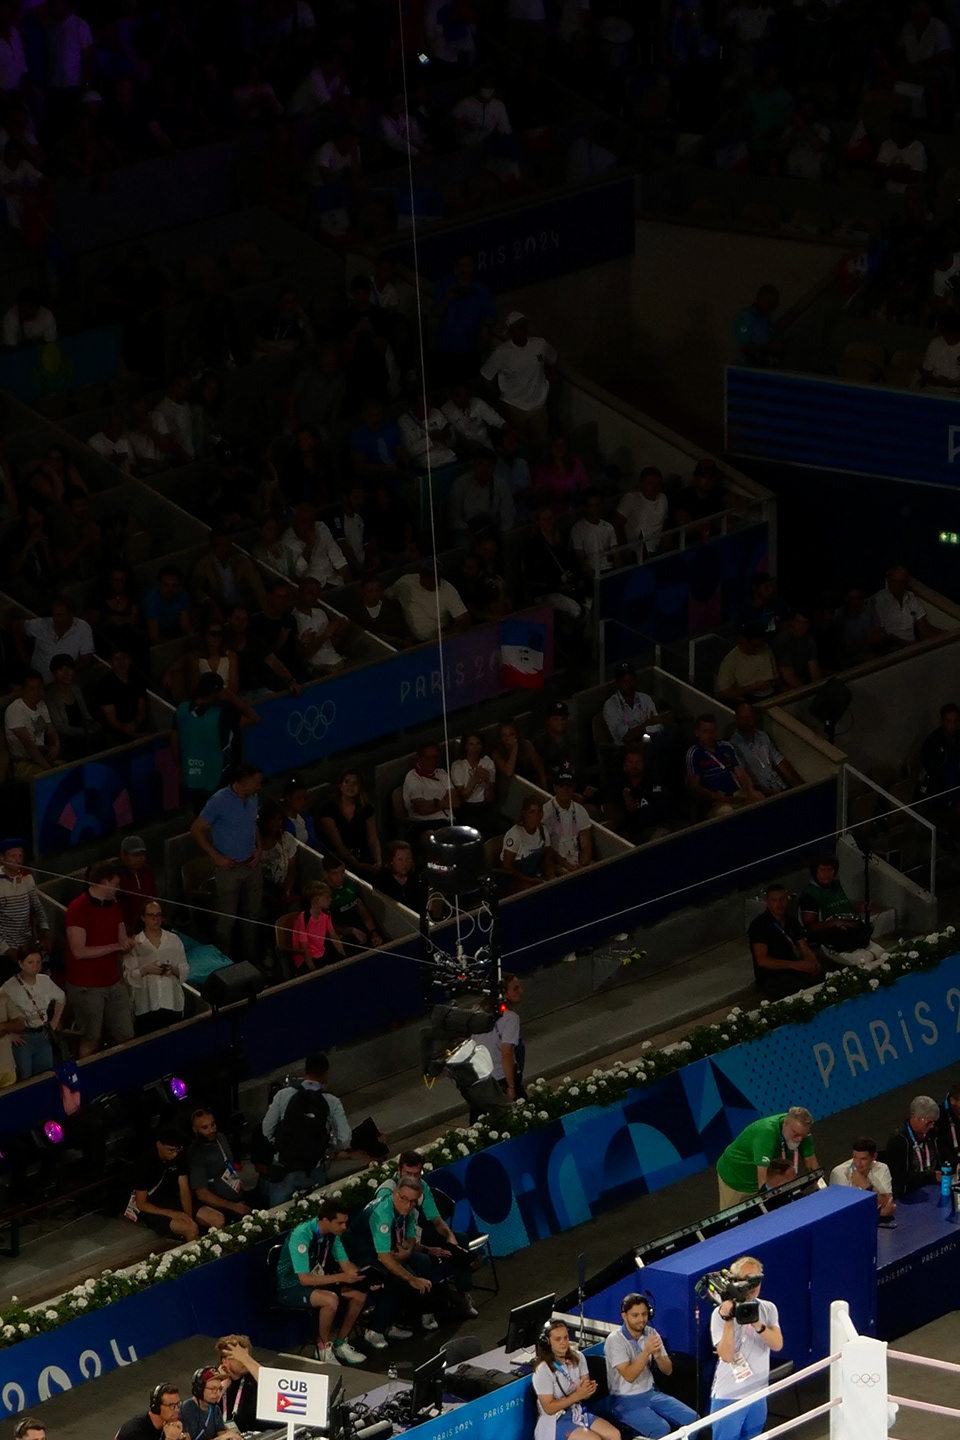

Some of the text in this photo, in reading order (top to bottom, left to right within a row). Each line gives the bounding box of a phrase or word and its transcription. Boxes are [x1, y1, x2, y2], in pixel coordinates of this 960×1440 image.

[513, 228, 560, 260] 2024
[940, 1241, 957, 1257] 2024
[896, 1264, 913, 1278] 2024
[278, 1378, 308, 1393] CUB
[505, 1396, 525, 1411] 2024
[454, 1419, 474, 1434] 2024
